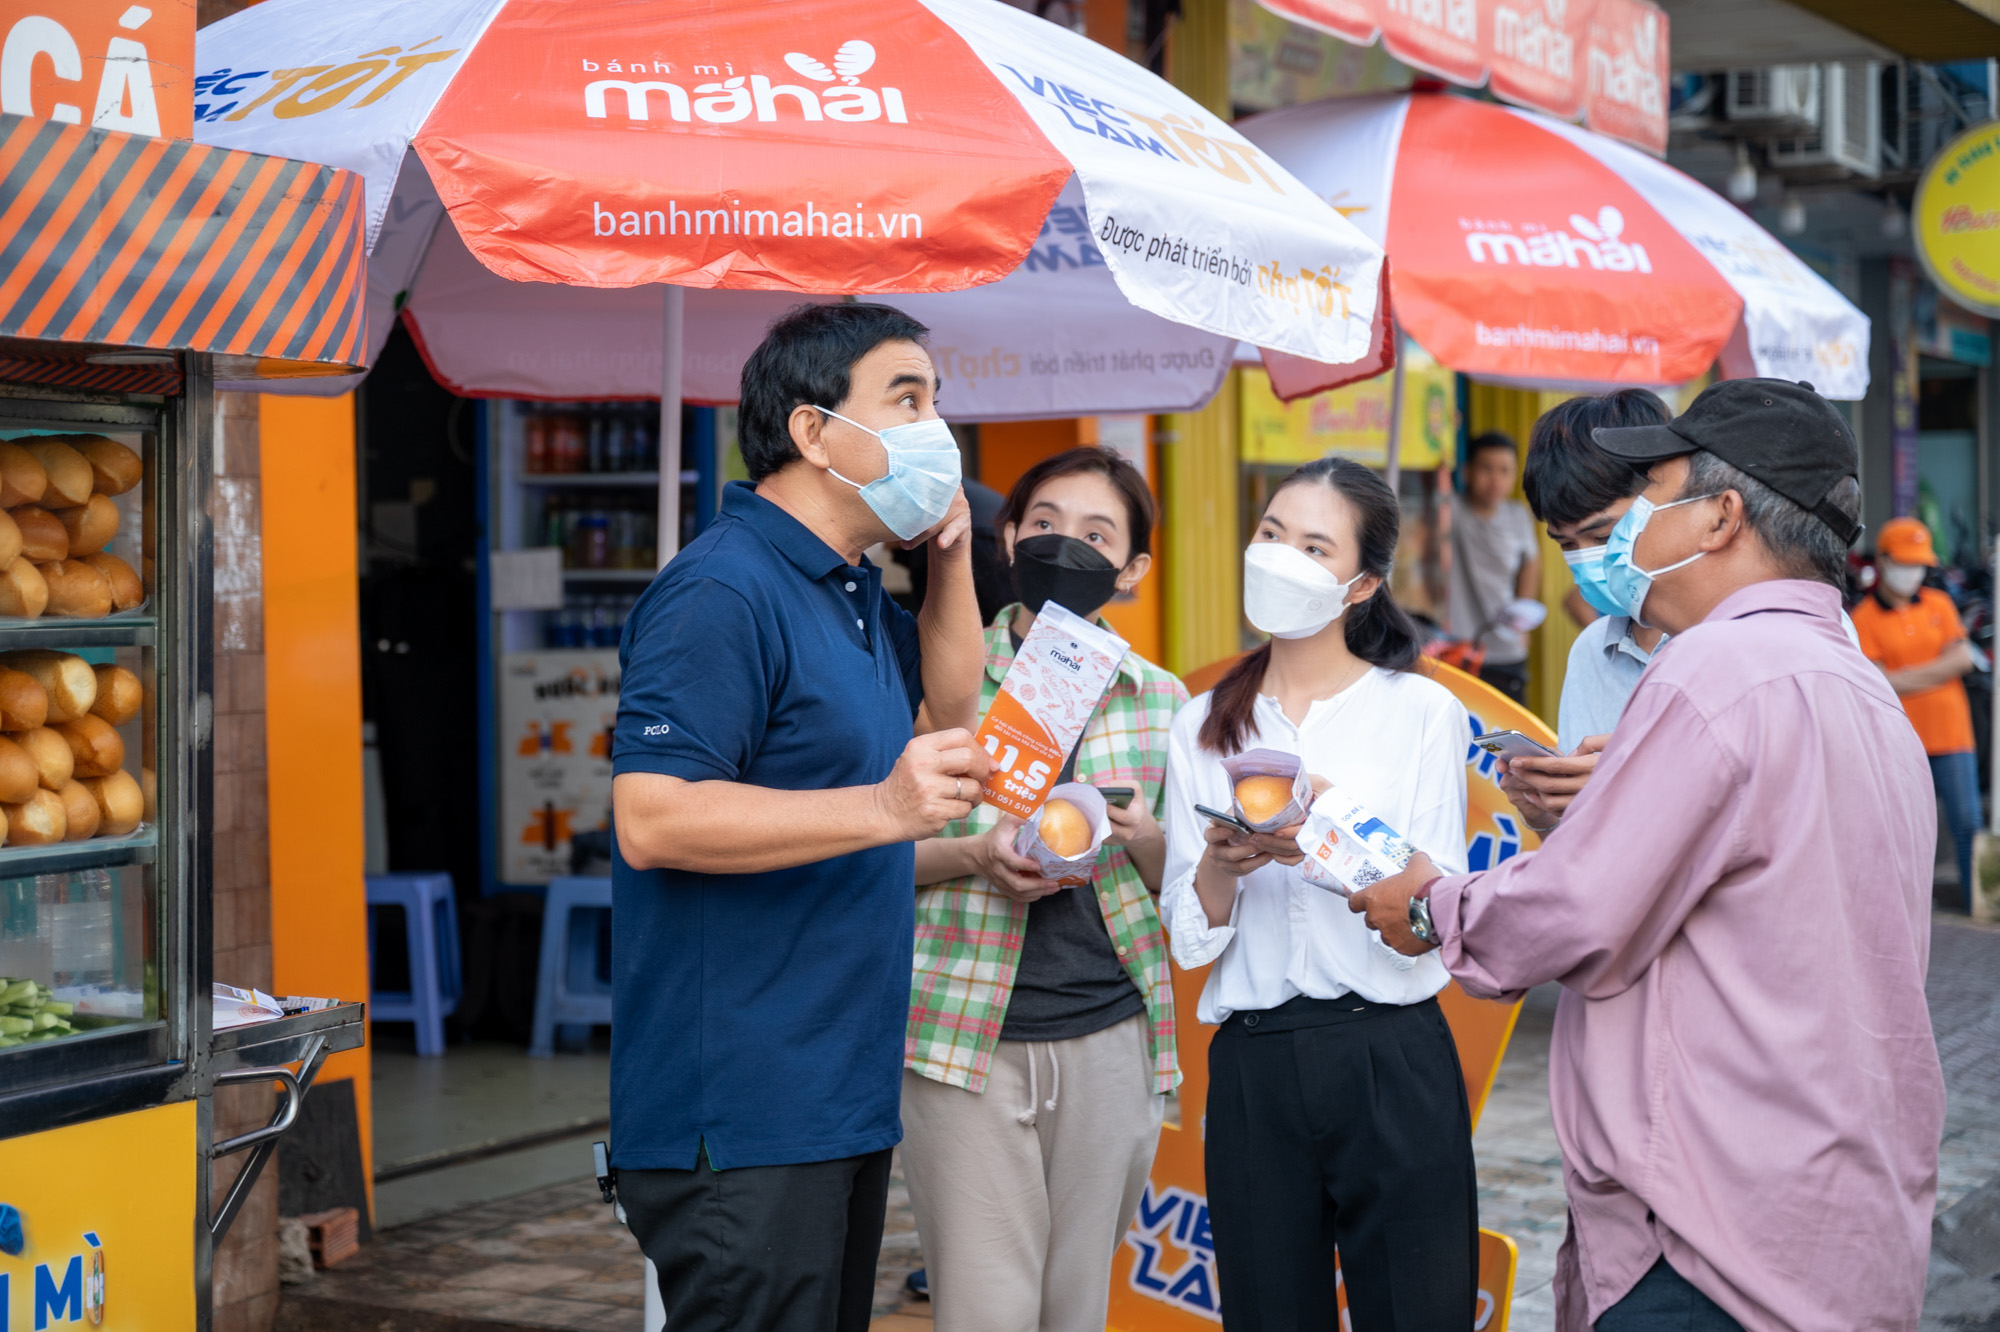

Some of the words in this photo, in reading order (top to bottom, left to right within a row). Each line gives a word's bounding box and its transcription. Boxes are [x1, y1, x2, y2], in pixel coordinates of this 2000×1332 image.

[582, 59, 671, 74] bánh
[694, 62, 734, 76] mì
[592, 199, 923, 239] banhmimahai.vn
[1100, 216, 1145, 254] Được
[1145, 232, 1189, 266] phát
[1192, 245, 1230, 280] triển
[1231, 255, 1253, 288] bởi
[1475, 320, 1660, 356] banhmimahai.vn
[643, 724, 670, 736] POLO
[984, 734, 1051, 790] 11.5
[997, 794, 1013, 806] 051
[1004, 779, 1037, 800] triệu
[1134, 1238, 1222, 1312] LÀ
